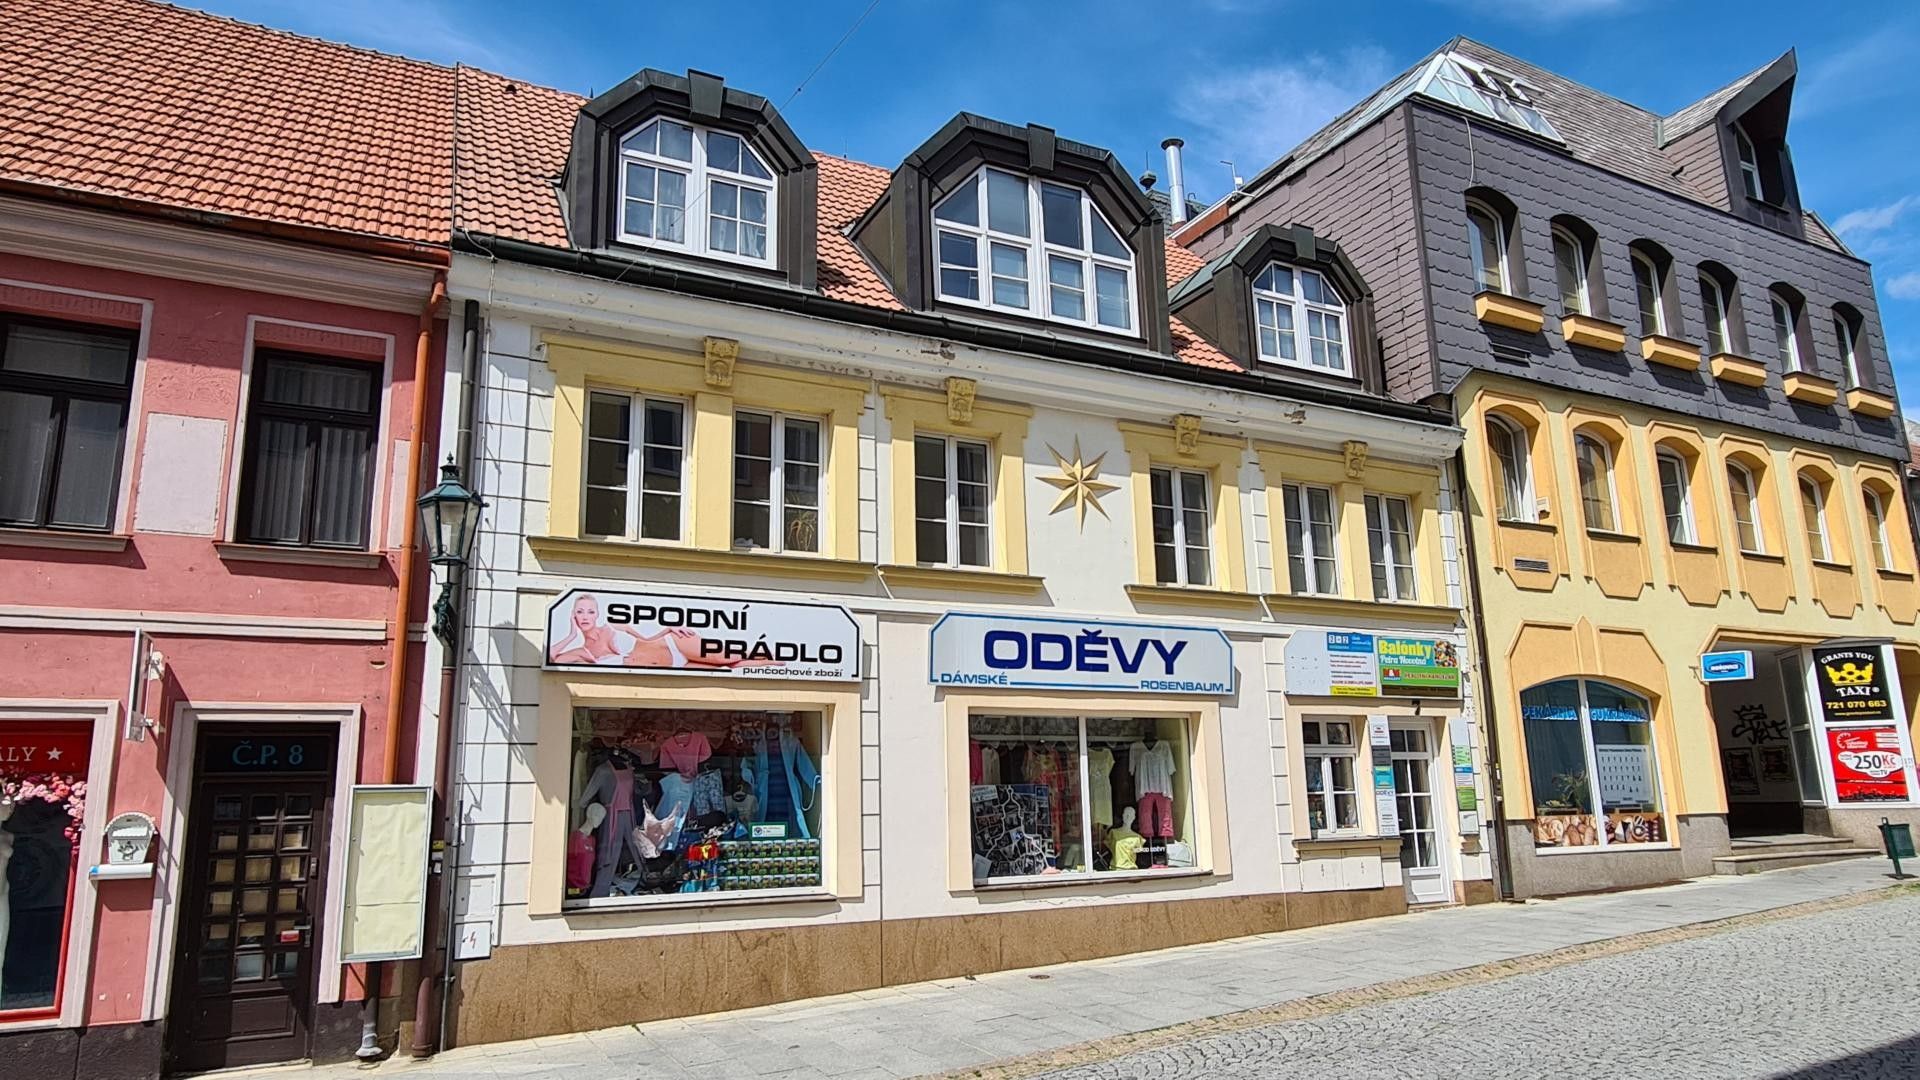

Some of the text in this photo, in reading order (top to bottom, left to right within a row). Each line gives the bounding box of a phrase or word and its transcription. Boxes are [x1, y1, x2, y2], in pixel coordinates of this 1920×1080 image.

[607, 604, 749, 630] SPODNÍ
[701, 633, 842, 663] PRÁDLO
[984, 629, 1188, 675] ODĚVY
[1379, 640, 1432, 659] Balónky
[1821, 652, 1875, 664] GRANTS YOU
[743, 667, 843, 678] punčochové zboží
[940, 671, 1008, 685] DÁMSKÉ
[1140, 680, 1224, 692] ROSENBAUM
[1836, 686, 1871, 697] TAXI
[1826, 701, 1844, 709] 721
[288, 744, 303, 765] 8
